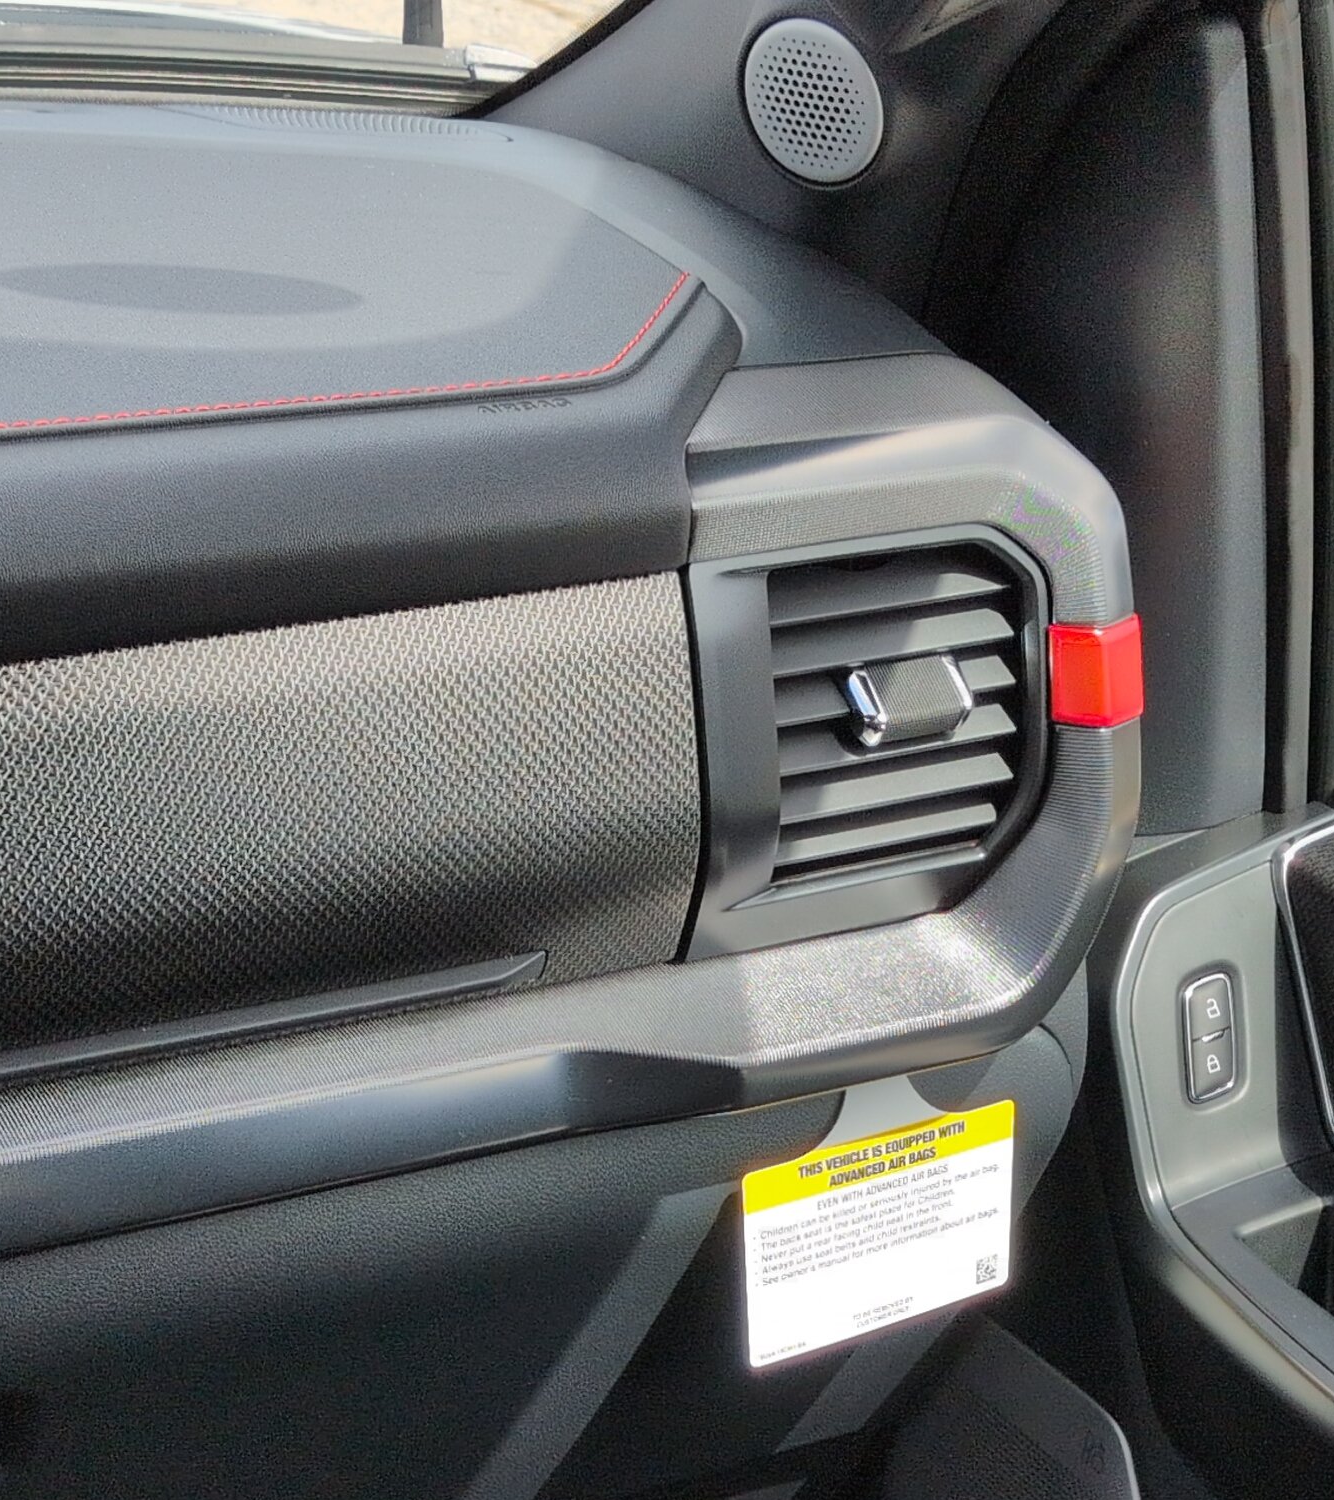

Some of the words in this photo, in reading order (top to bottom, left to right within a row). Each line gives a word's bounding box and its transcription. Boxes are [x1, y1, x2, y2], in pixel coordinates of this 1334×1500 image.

[798, 1161, 823, 1179] THIS
[825, 1148, 869, 1171] VEHICLE
[872, 1145, 883, 1158] IS
[885, 1130, 935, 1154] EQUIPPED
[939, 1121, 965, 1138] WITH
[829, 1161, 885, 1187] ADVANCED
[888, 1155, 906, 1171] AIR
[909, 1146, 936, 1164] BAGS
[760, 1224, 799, 1240] Children
[801, 1218, 817, 1228] can
[819, 1215, 830, 1223] be
[832, 1206, 856, 1219] killed
[858, 1203, 867, 1212] or
[911, 1180, 940, 1195] injured
[955, 1173, 968, 1182] the
[970, 1169, 981, 1178] air
[817, 1197, 839, 1210] EVEN
[842, 1189, 863, 1203] WITH
[866, 1176, 909, 1196] ADVANCED
[911, 1171, 925, 1183] AIR
[927, 1164, 948, 1178] BAGS
